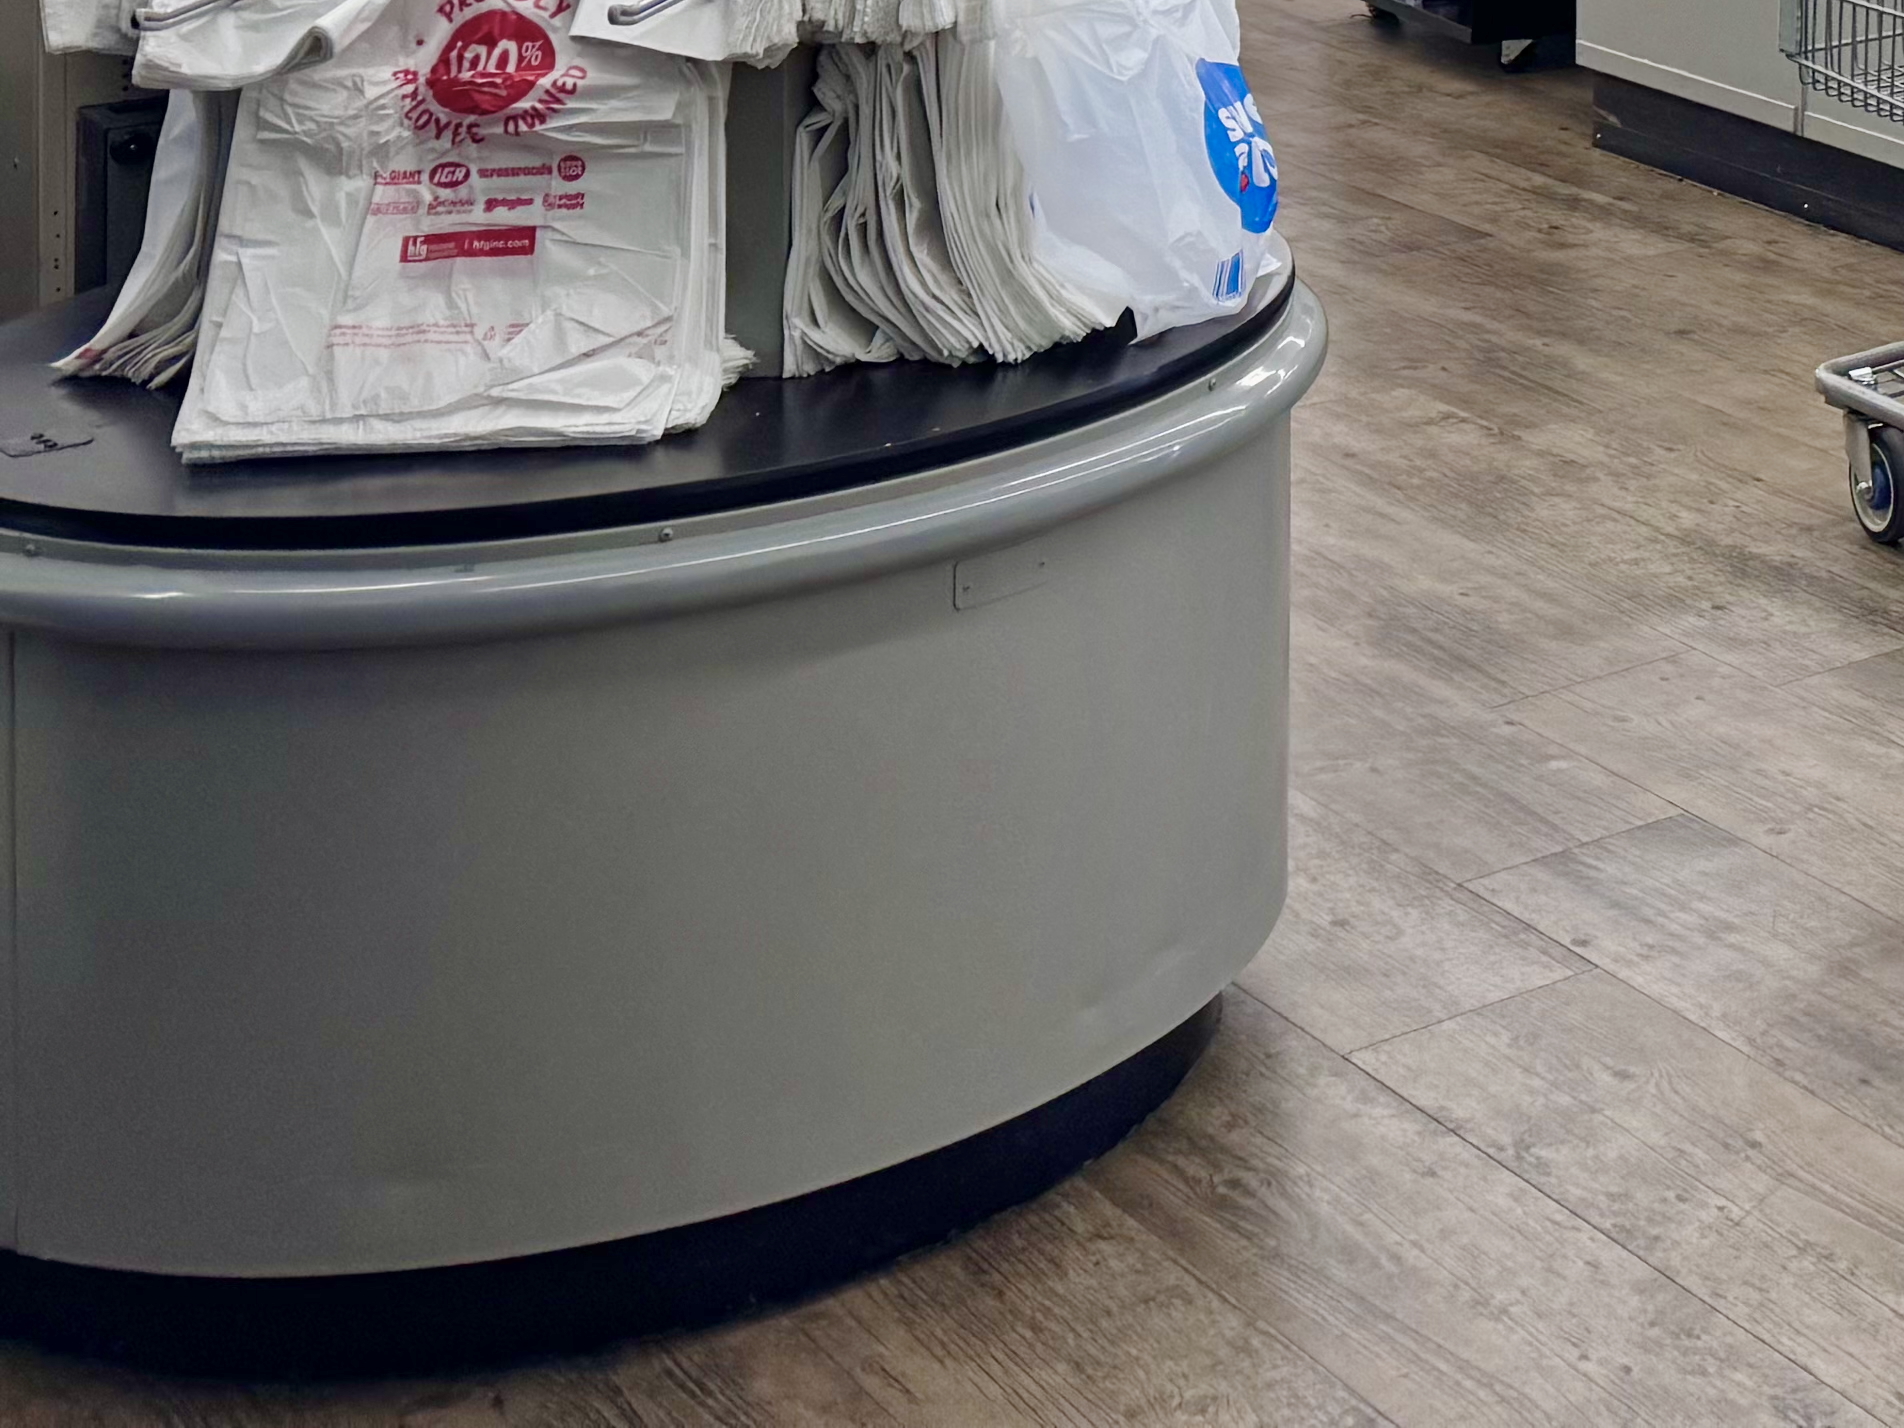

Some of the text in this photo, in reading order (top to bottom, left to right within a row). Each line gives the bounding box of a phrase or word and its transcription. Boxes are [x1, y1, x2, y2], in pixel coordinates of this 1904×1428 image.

[449, 39, 544, 79] 100%
[503, 65, 588, 137] OWNED
[432, 165, 467, 184] IGA
[408, 237, 428, 260] hfg
